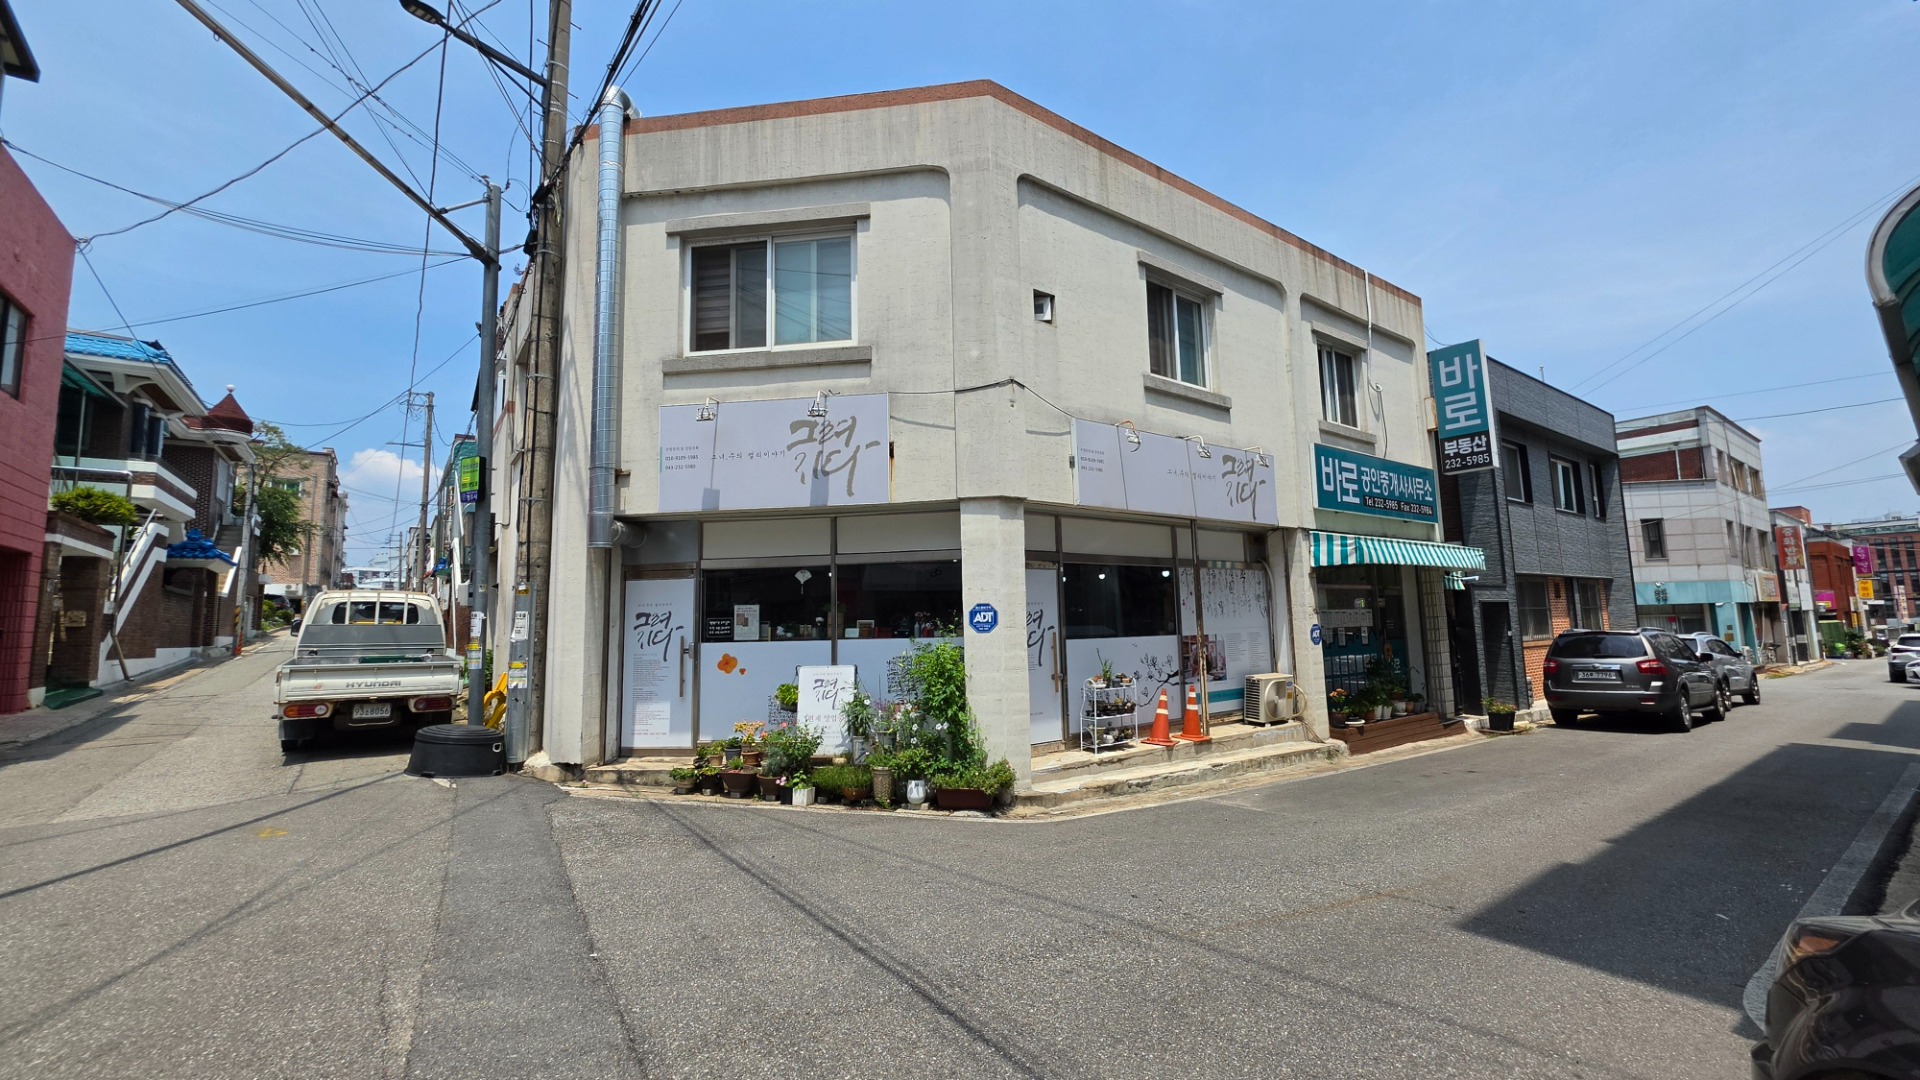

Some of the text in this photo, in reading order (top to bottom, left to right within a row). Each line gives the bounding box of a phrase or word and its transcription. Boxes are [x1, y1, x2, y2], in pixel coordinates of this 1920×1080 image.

[1438, 353, 1482, 431] 바로
[1444, 436, 1487, 455] 부동산
[1444, 454, 1490, 470] 232-5985
[1320, 456, 1434, 504] 바로 공인중개사사무소
[1374, 497, 1399, 511] 232-5985
[973, 611, 994, 623] ADT
[345, 680, 402, 688] HYUNDAI
